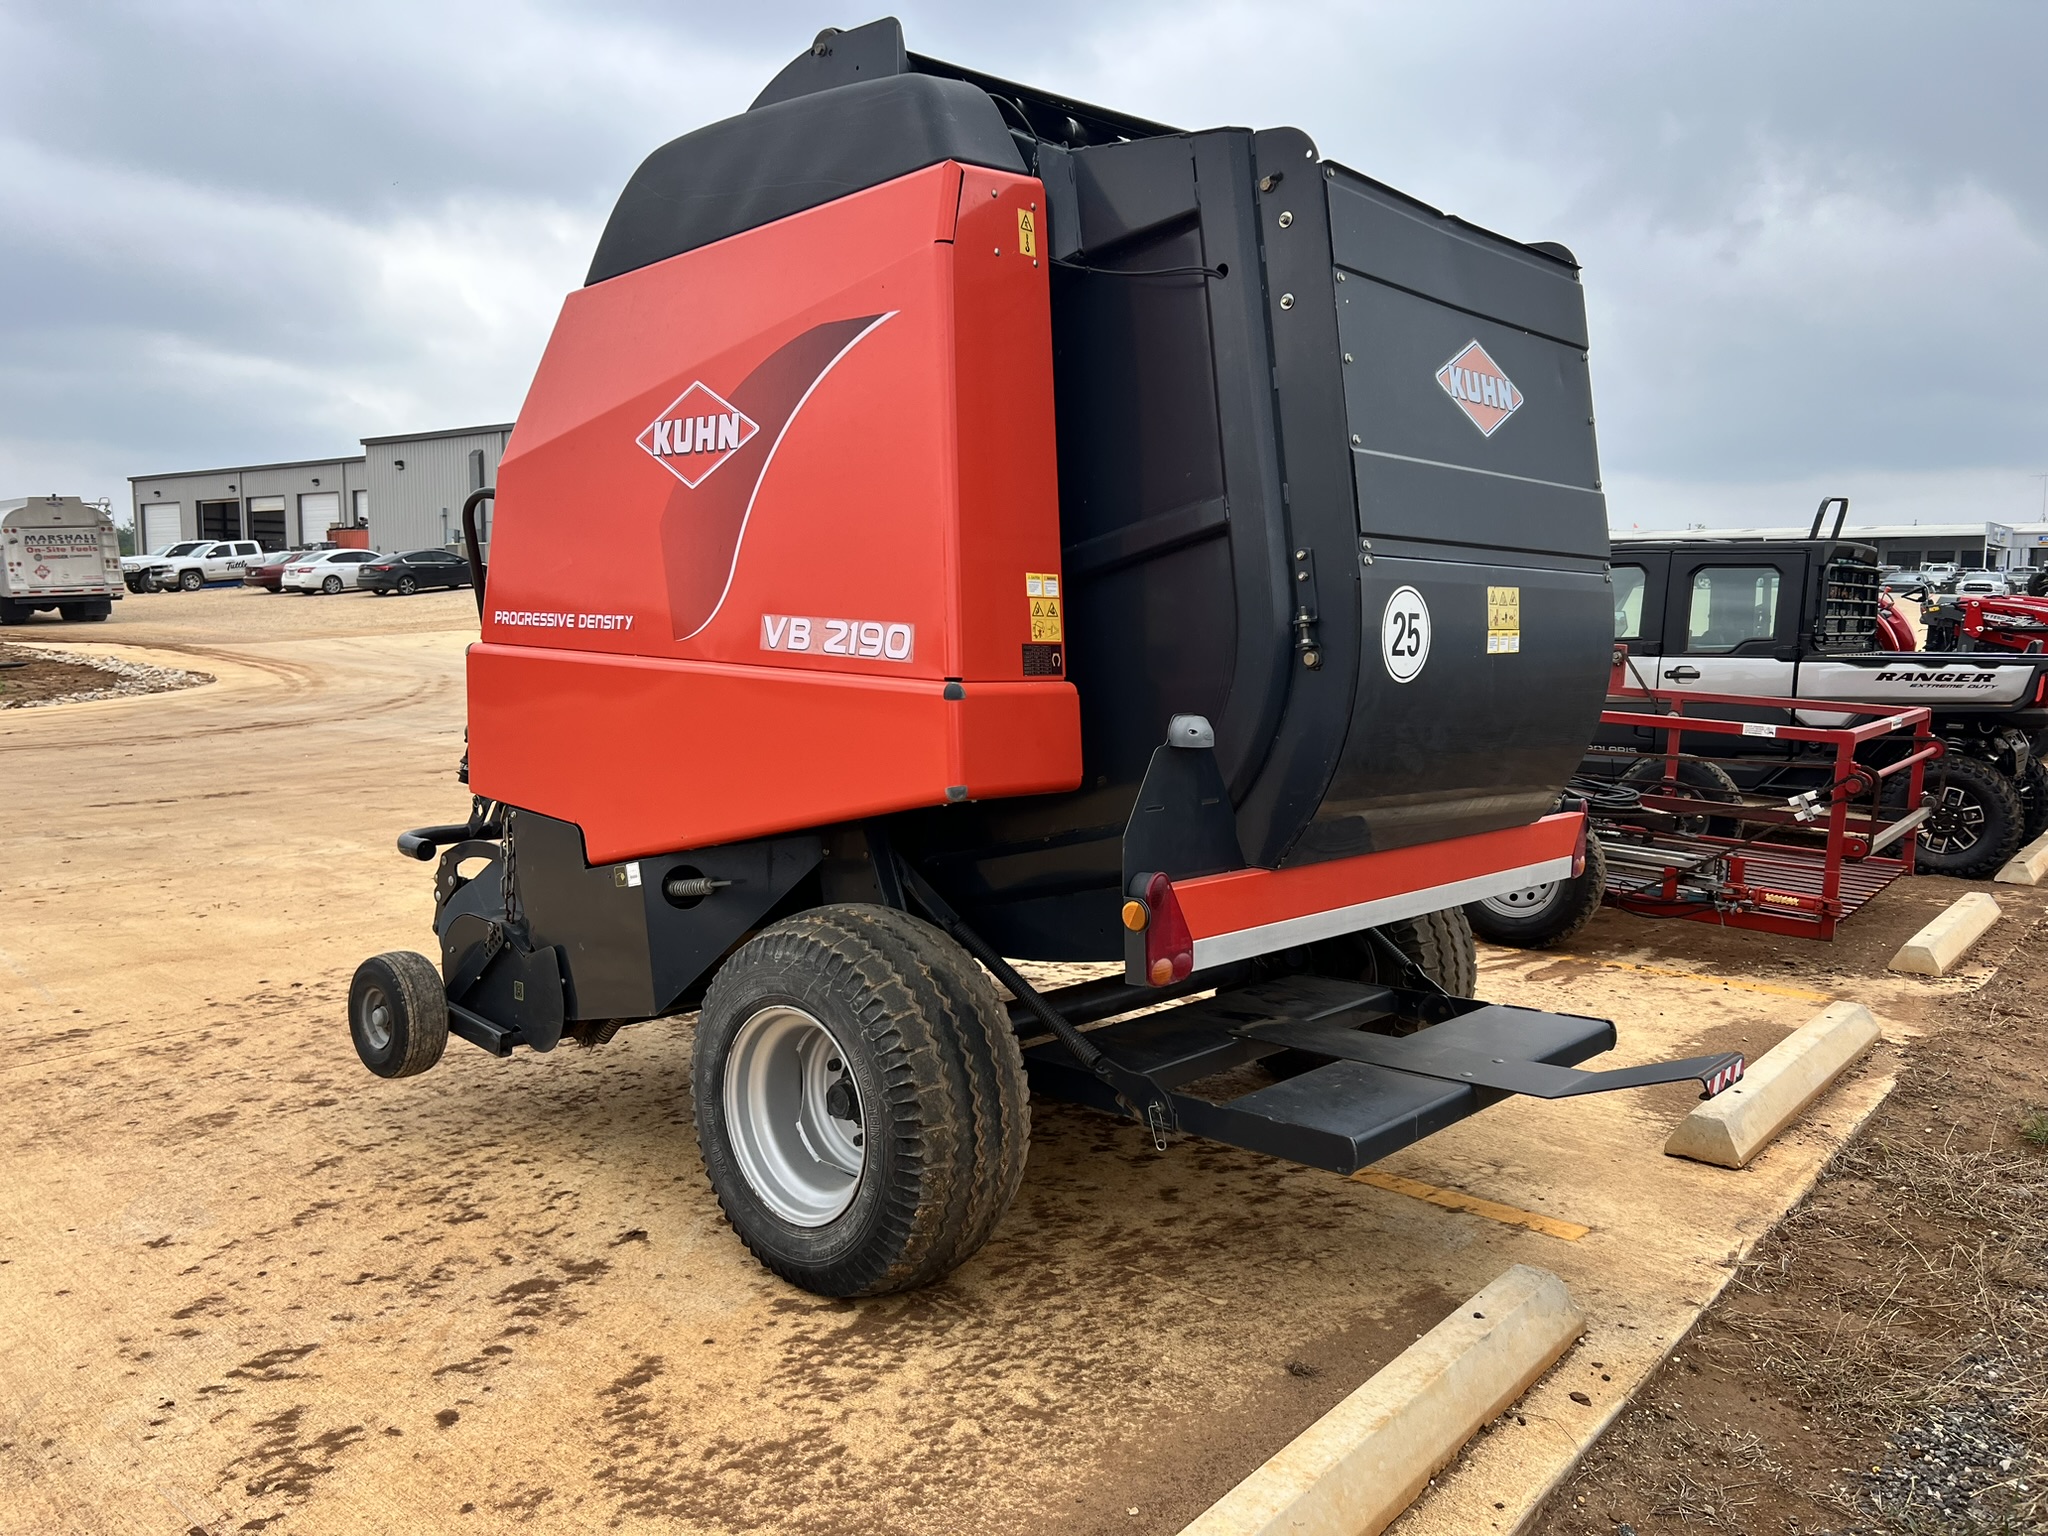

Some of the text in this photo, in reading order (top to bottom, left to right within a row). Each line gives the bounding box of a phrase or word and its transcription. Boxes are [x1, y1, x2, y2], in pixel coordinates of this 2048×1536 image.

[1448, 364, 1514, 412] KUHN
[652, 412, 741, 457] KUHN
[494, 611, 633, 630] PROGRESSIVE DENSITY
[763, 615, 911, 660] VB 2190
[1391, 611, 1421, 657] 25
[1875, 672, 1996, 683] RANGER
